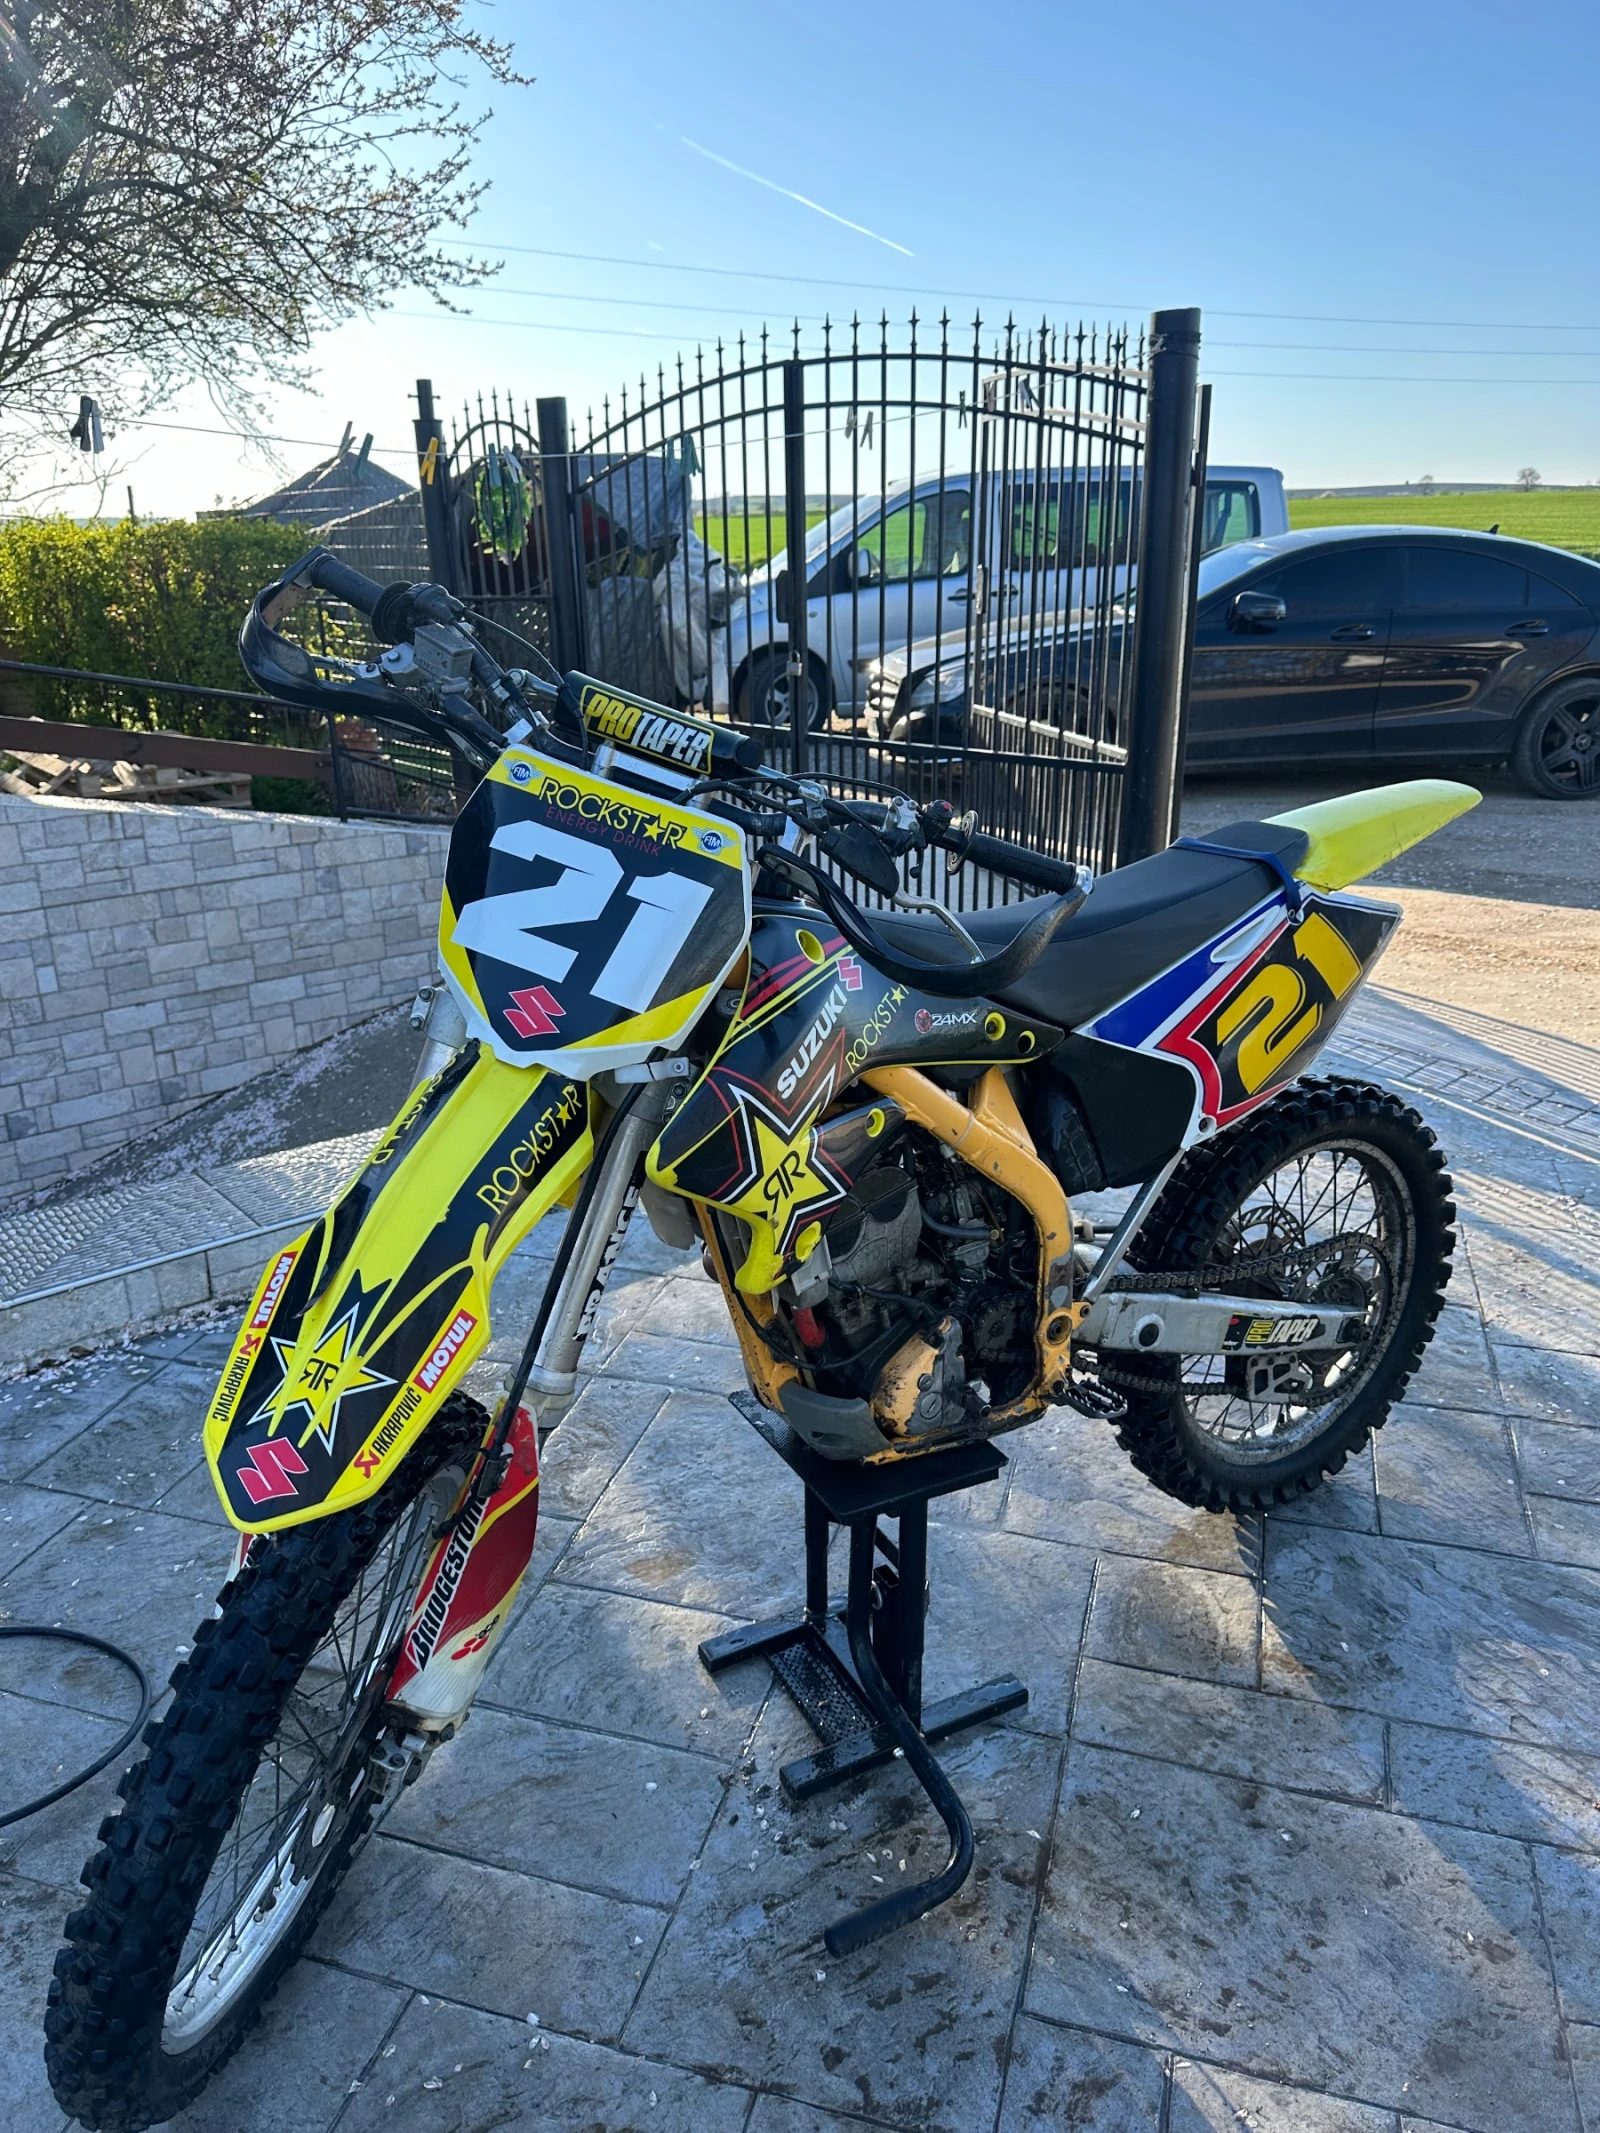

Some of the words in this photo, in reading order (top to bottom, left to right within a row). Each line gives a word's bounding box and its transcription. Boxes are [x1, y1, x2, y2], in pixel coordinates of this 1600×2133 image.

[513, 766, 530, 779] FIM
[545, 806, 608, 837] ENERGY
[613, 830, 662, 857] DRINK
[704, 835, 721, 848] FIM
[451, 819, 714, 1014] 21
[931, 1012, 978, 1027] 24MX
[1217, 911, 1363, 1096] 21
[777, 983, 848, 1100] SUZUKI
[253, 1256, 293, 1328] MOTUL
[421, 1316, 473, 1388] MOTUL
[1266, 1319, 1319, 1343] TAPER
